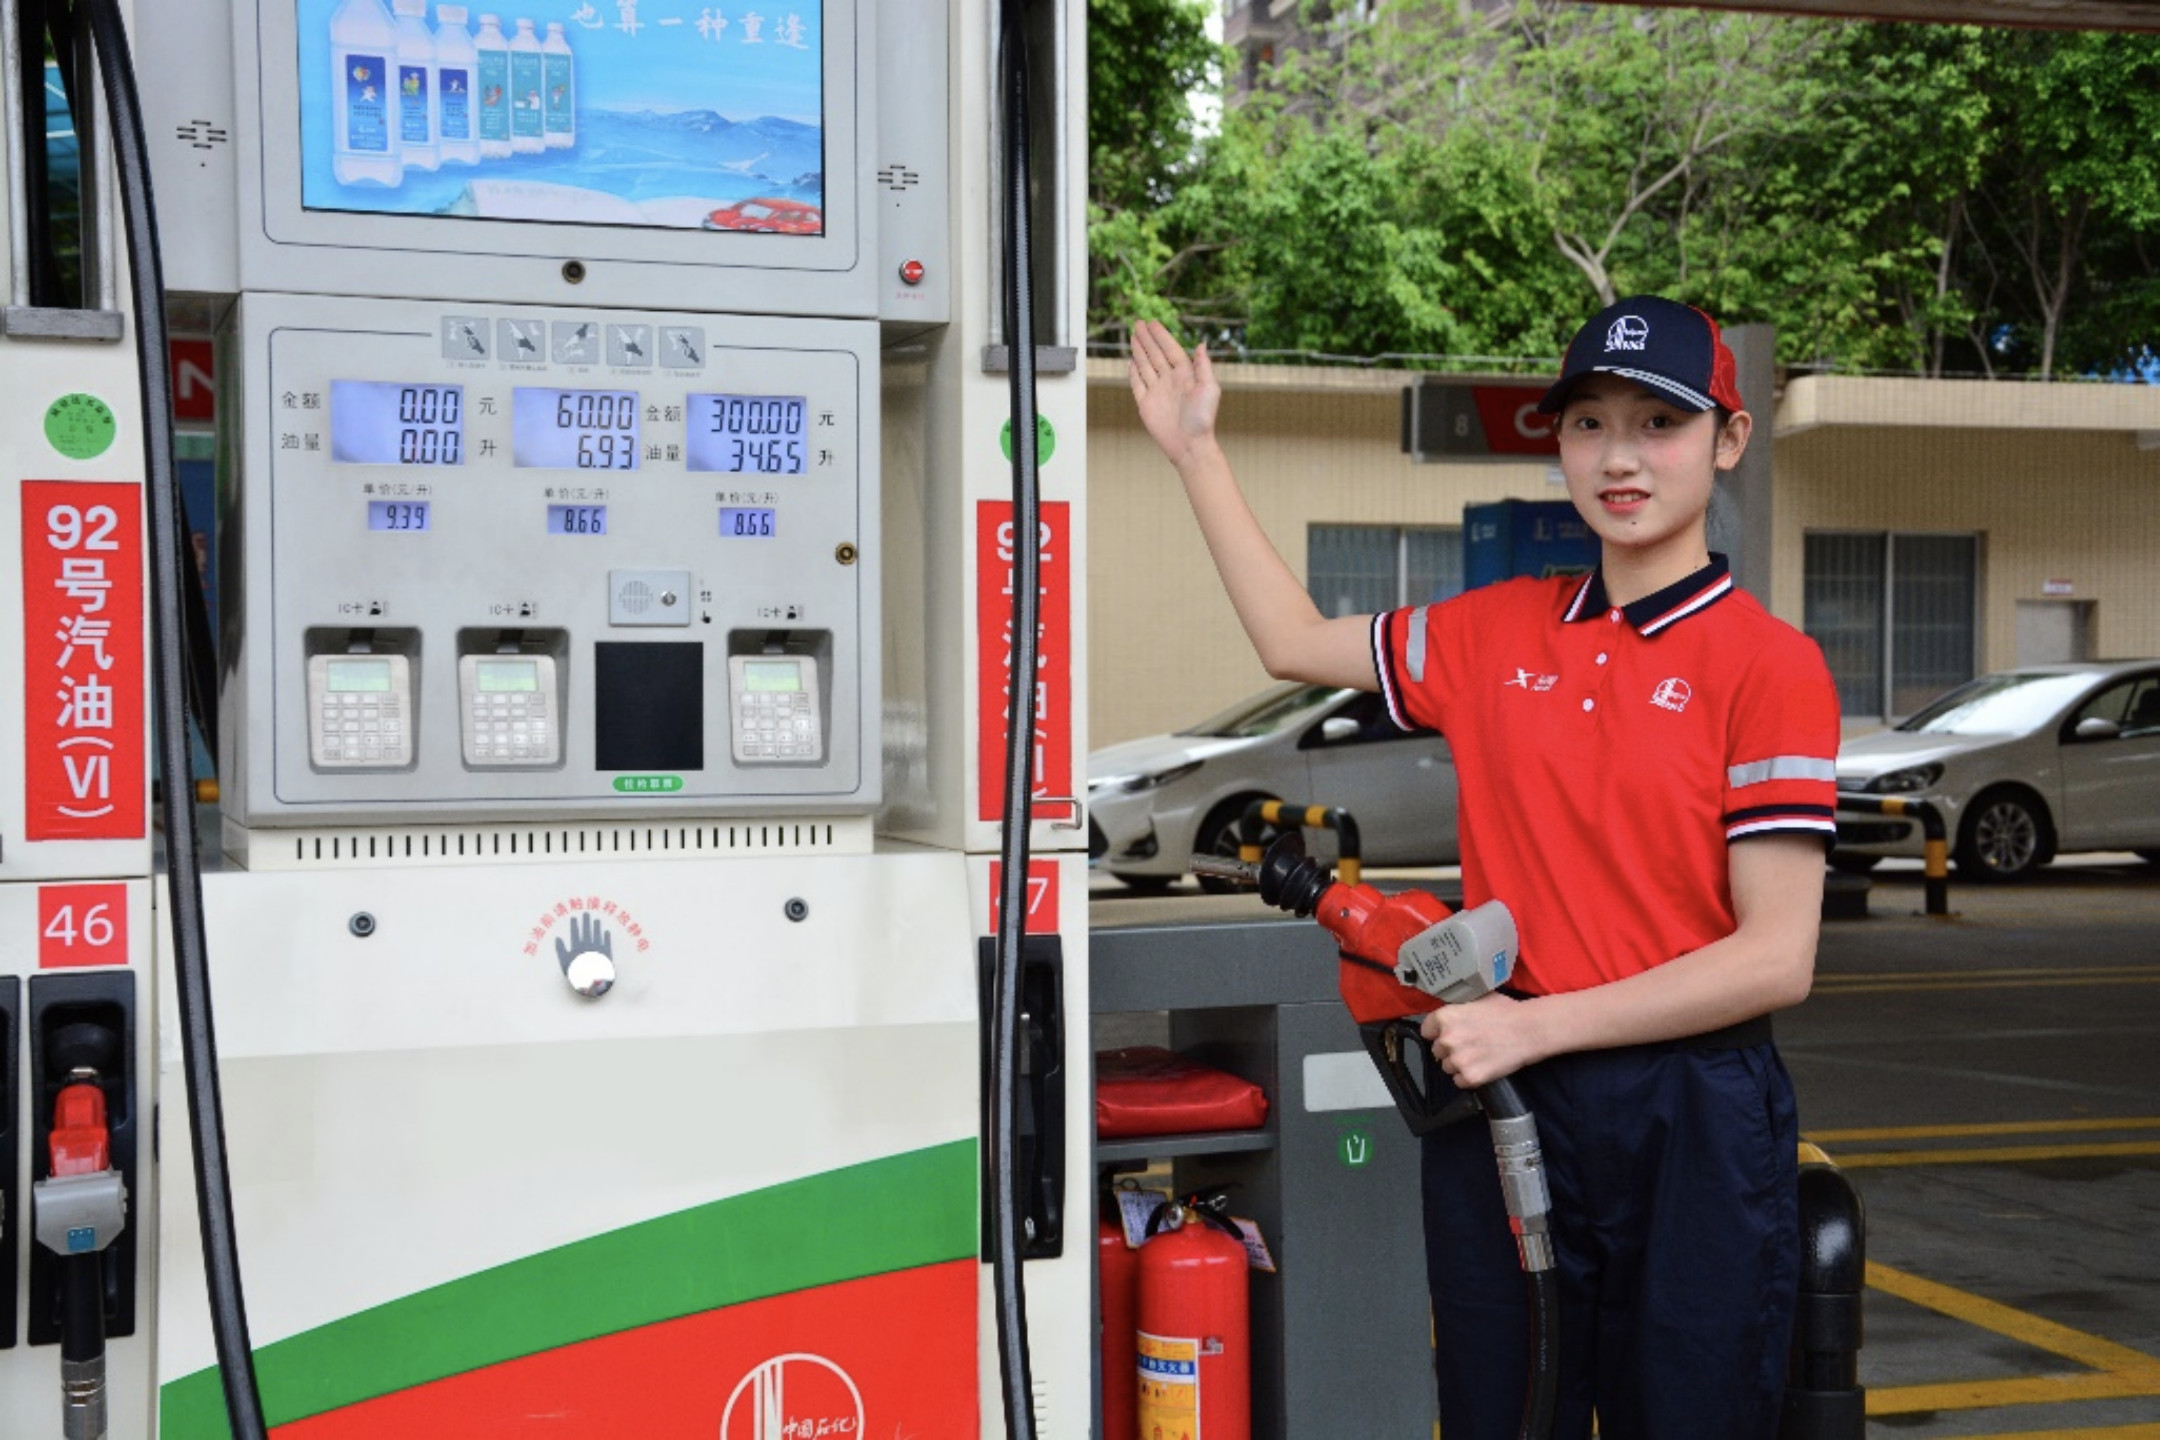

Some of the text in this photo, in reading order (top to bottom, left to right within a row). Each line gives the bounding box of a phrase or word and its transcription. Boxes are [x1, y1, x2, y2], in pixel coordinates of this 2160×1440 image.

[281, 391, 321, 410] 金额
[400, 388, 460, 424] 0.00
[479, 396, 498, 416] 元
[557, 394, 634, 430] 60.00
[646, 405, 681, 423] 金额
[711, 399, 801, 434] 300.00
[818, 409, 835, 427] 元
[281, 432, 321, 451] 油量
[400, 429, 460, 464] 0.00
[479, 438, 498, 458] 升
[577, 435, 634, 470] 6.93
[646, 444, 681, 462] 油量
[730, 440, 801, 474] 34.65
[818, 449, 835, 467] 升
[386, 504, 425, 530] 9.39
[564, 508, 601, 533] 8.66
[734, 512, 769, 536] 8.66
[995, 877, 1049, 915] 7
[44, 903, 114, 947] 46
